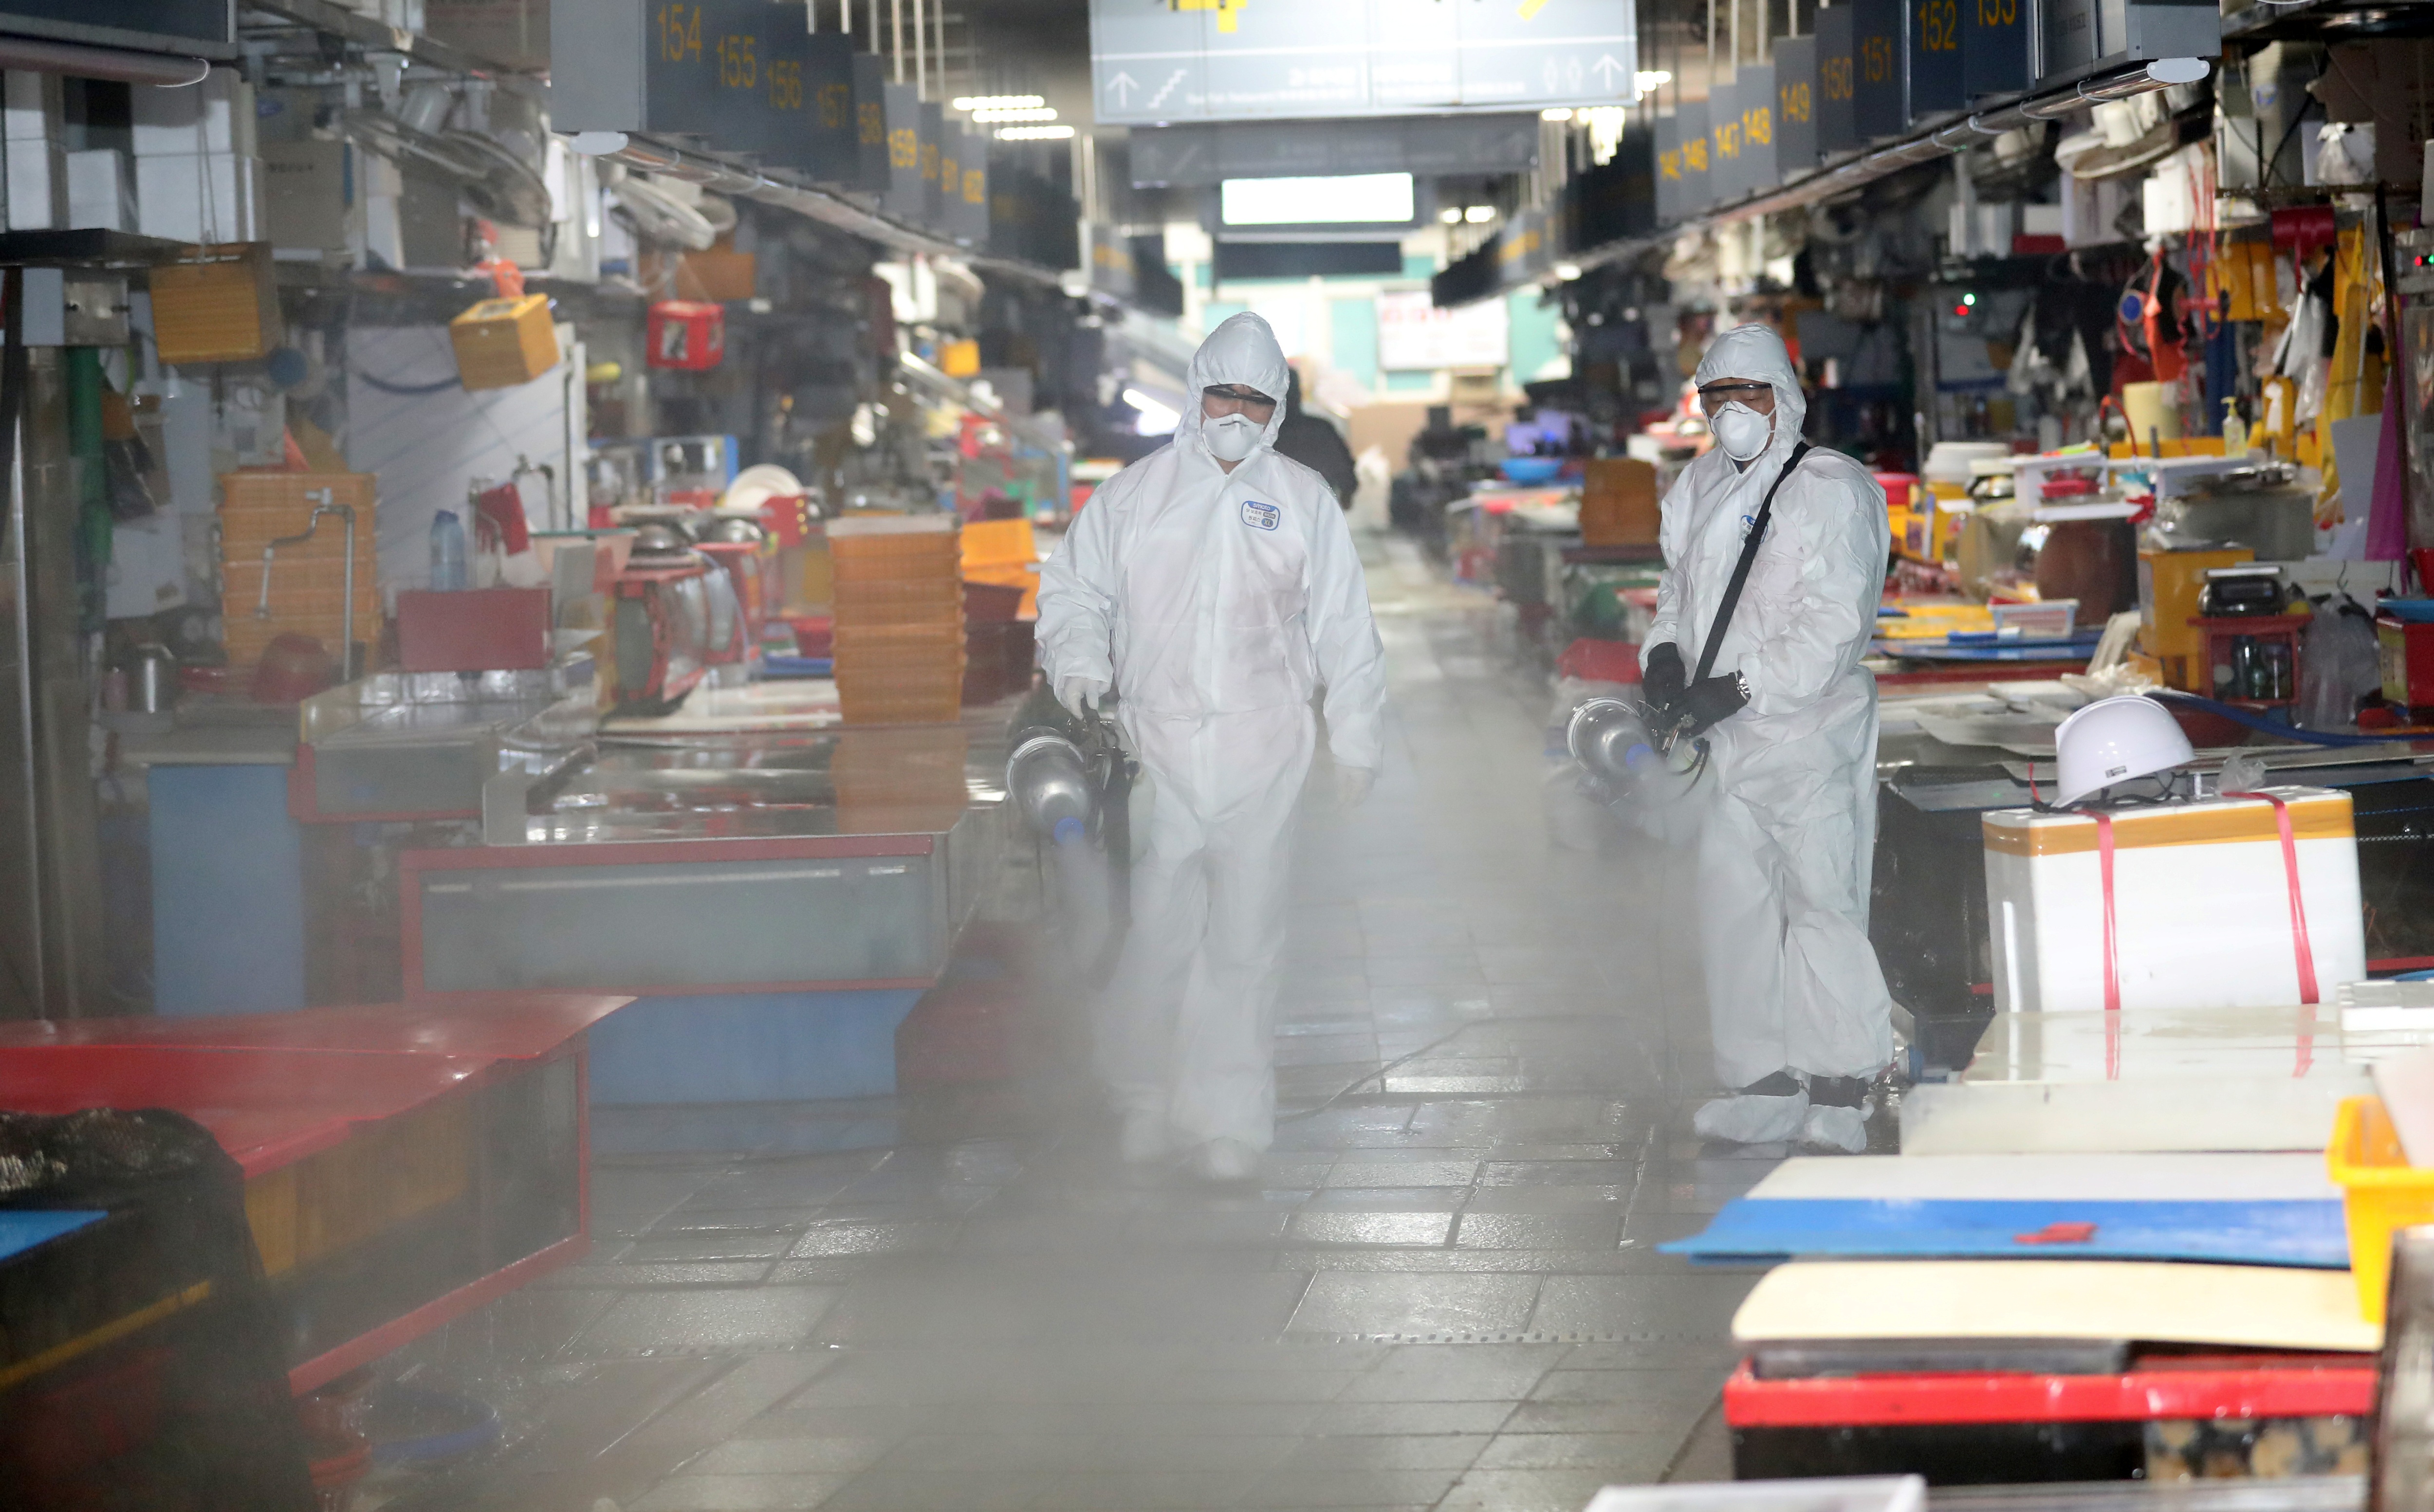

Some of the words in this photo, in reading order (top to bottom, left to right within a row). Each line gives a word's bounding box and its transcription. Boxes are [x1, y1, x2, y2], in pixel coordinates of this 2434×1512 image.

[658, 4, 702, 63] 154
[1918, 1, 1956, 51] 152
[717, 34, 756, 89] 155
[1822, 57, 1853, 100] 150
[1862, 36, 1892, 81] 151
[767, 59, 802, 109] 156
[817, 83, 848, 128] 157
[1781, 82, 1810, 123] 149
[858, 102, 882, 144] 58
[1715, 122, 1740, 159] 147
[1743, 107, 1771, 146] 148
[887, 128, 917, 168] 159
